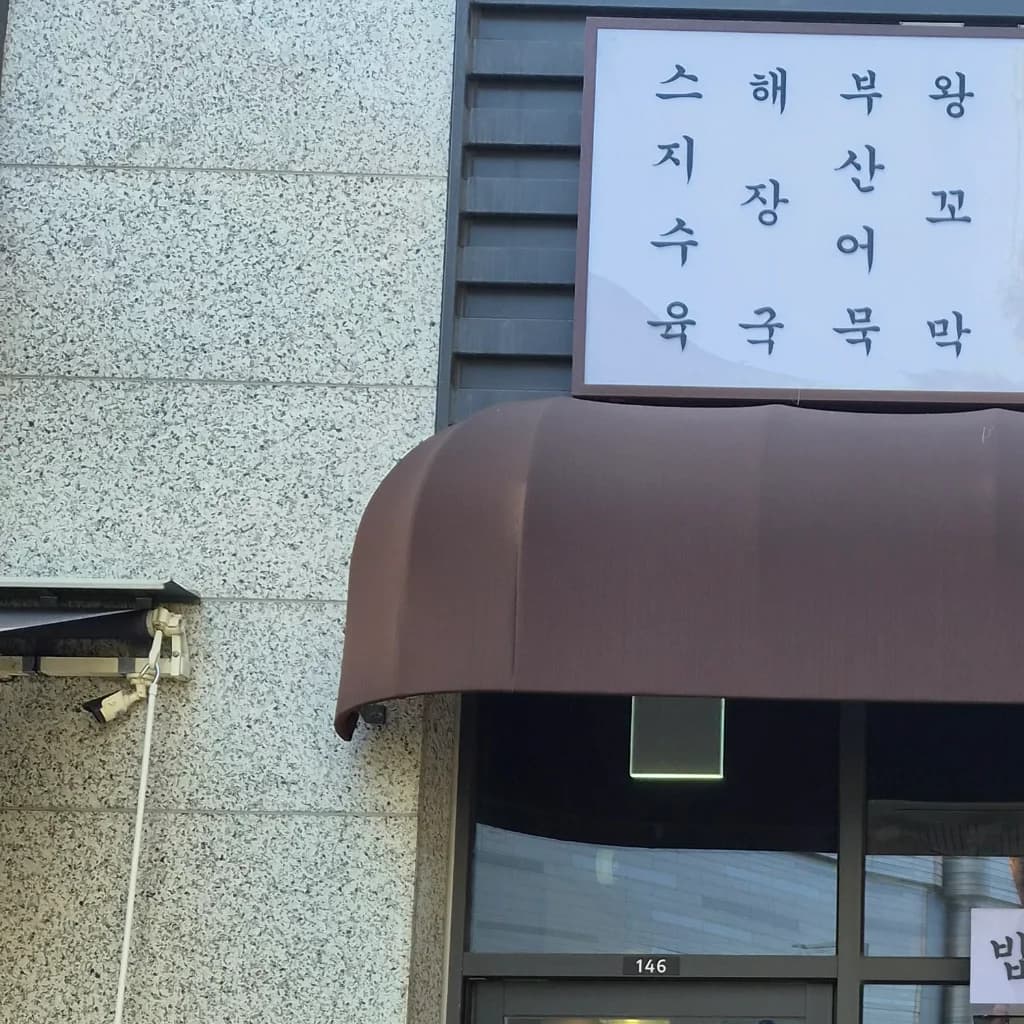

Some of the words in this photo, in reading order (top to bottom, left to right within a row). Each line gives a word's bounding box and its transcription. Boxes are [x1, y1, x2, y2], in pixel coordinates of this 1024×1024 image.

[646, 64, 703, 352] 스지수육
[738, 66, 790, 356] 해장국
[832, 69, 885, 357] 부산어묵
[925, 71, 975, 358] 왕꼬막
[636, 958, 667, 974] 146
